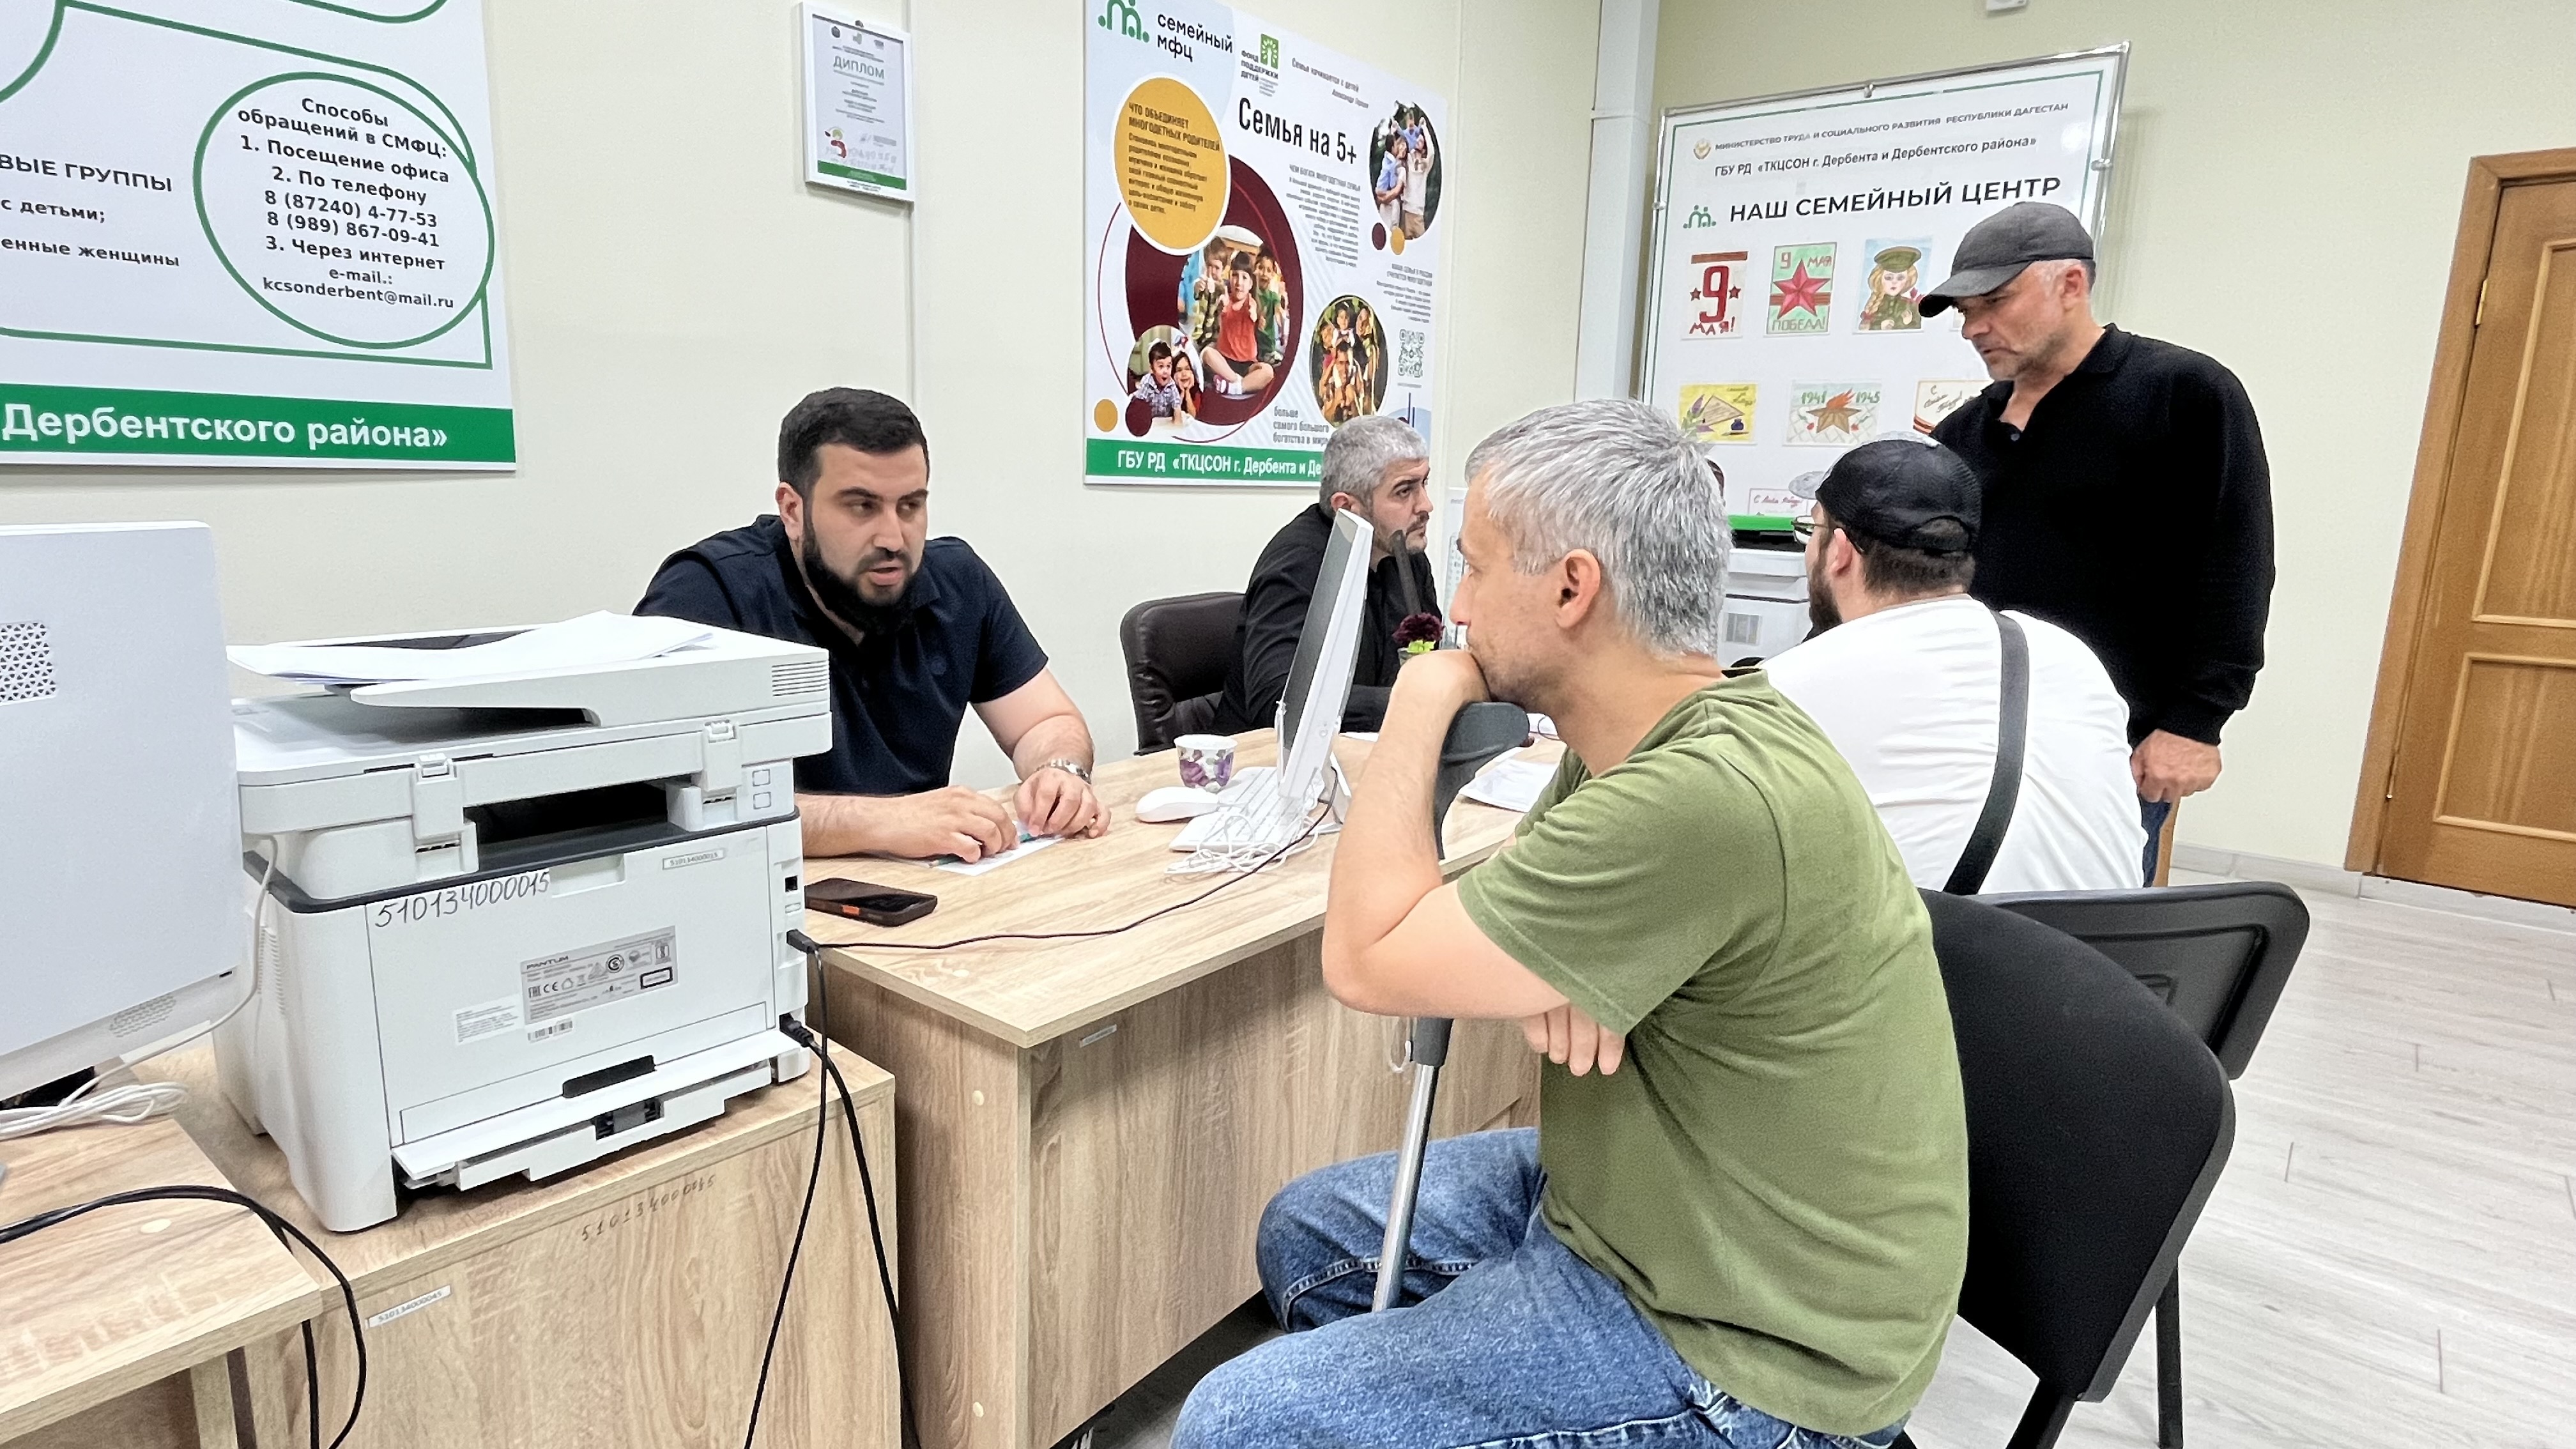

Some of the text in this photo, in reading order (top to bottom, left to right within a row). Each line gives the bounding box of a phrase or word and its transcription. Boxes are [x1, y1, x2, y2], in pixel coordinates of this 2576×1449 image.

[1157, 13, 1232, 54] семейный
[1157, 34, 1193, 63] мфц
[833, 56, 885, 79] ДИПЛОМ
[302, 98, 388, 127] Способы
[1129, 102, 1142, 115] ЧТО
[238, 109, 447, 159] обращений в СМФЦ:
[1239, 98, 1302, 148] Семья
[1310, 128, 1330, 157] на
[1337, 132, 1357, 164] 5+
[1715, 137, 1781, 150] МИНИСТЕРСТВО
[1783, 133, 1810, 142] ТРУДА
[1821, 124, 1890, 138] СОЦИАЛЬНОГО
[1891, 118, 1941, 130] РАЗВИТИЯ
[1946, 109, 2012, 124] РЕСПУБЛИКИ
[2013, 103, 2069, 117] ДАГЕСТАН
[240, 135, 448, 183] 1. Посещение офиса
[1715, 137, 2037, 177] ГБУ РД «ТКЦСОН г. Дербента и Дербентского района»
[65, 163, 172, 192] ГРУППЫ
[272, 166, 427, 206] 2. По телефону
[1, 199, 105, 223] с детьми;
[265, 190, 438, 227] 8 (87240) 4-77-53
[1729, 176, 2062, 222] НАШ СЕМЕЙНЫЙ ЦЕНТР
[267, 211, 440, 247] 8 (989) 867-09-41
[1, 238, 180, 266] енные женщины
[266, 235, 445, 270] 3. Через интернет
[1780, 251, 1832, 269] 9 МАЯ
[329, 268, 393, 284] e-mail.:
[263, 277, 454, 309] kcsonderbent@mail.ru
[1699, 265, 1729, 323] 9
[1689, 316, 1735, 335] МАЯ!
[1801, 390, 1880, 404] 1941 1945
[1, 403, 447, 450] Дербентского района»
[1273, 421, 1298, 431] самого
[1117, 450, 1321, 477] ГБУ РД «ТКЦСОН г. Дербента и Де
[374, 871, 549, 928] 510134000015
[526, 955, 569, 970] PANTUM
